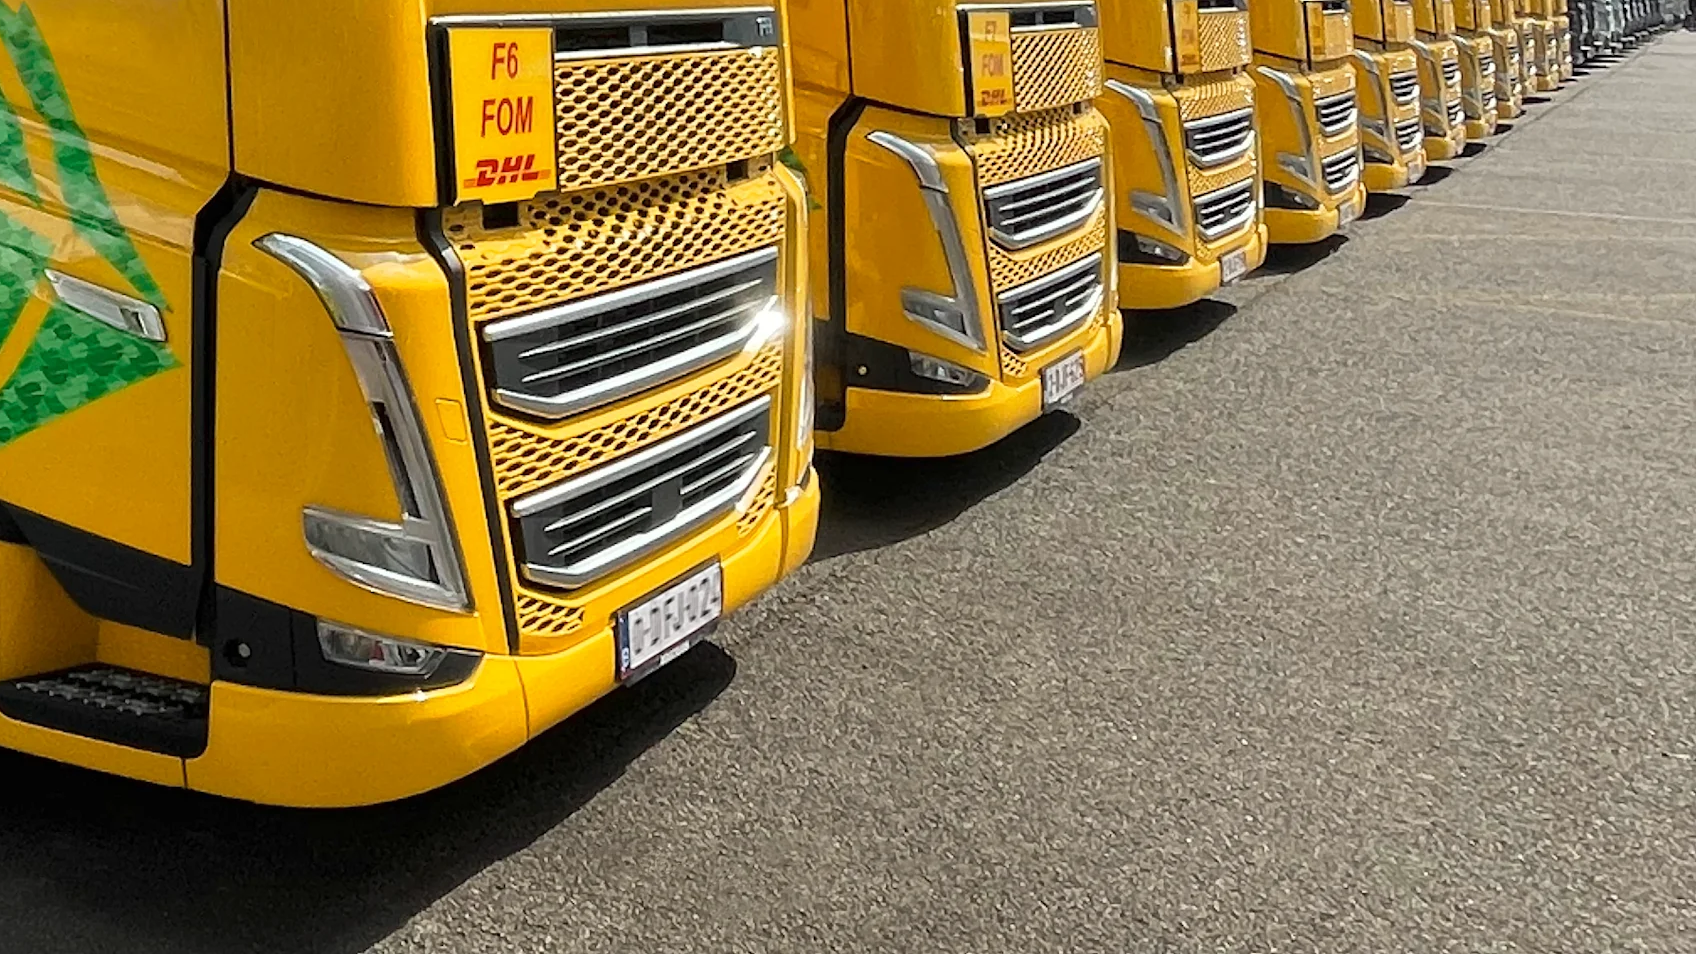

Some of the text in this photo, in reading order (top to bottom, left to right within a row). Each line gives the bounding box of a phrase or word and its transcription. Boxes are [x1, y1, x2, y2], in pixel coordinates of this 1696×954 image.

[491, 41, 519, 80] F6
[481, 96, 533, 137] FOM
[475, 154, 541, 187] DHL
